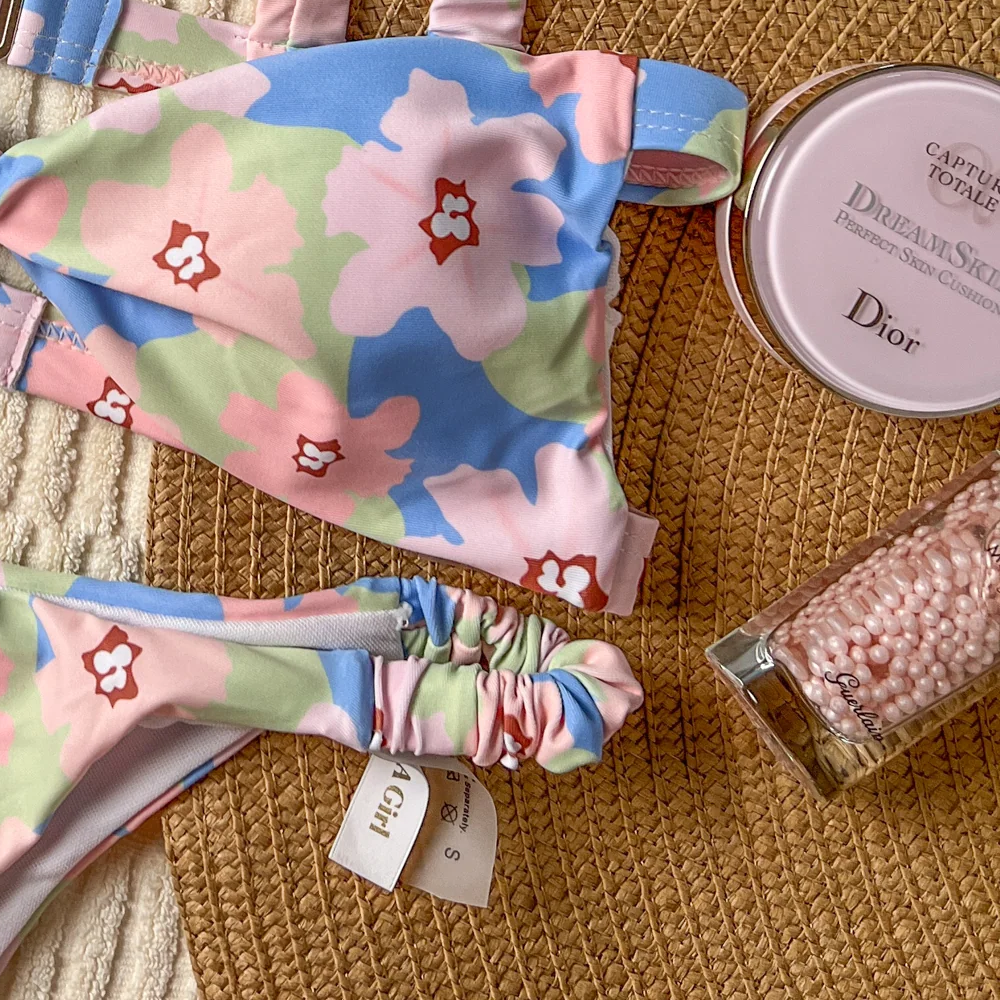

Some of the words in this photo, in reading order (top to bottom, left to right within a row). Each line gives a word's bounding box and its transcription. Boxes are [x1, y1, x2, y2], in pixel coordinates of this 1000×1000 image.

[926, 142, 1000, 195] CAPTUR
[928, 163, 999, 212] TOTALE
[833, 208, 898, 256] PERFECT
[898, 246, 936, 276] SKIN
[841, 288, 921, 354] Dior
[824, 670, 884, 745] Guerlain
[369, 784, 405, 838] Girl
[444, 847, 460, 862] S
